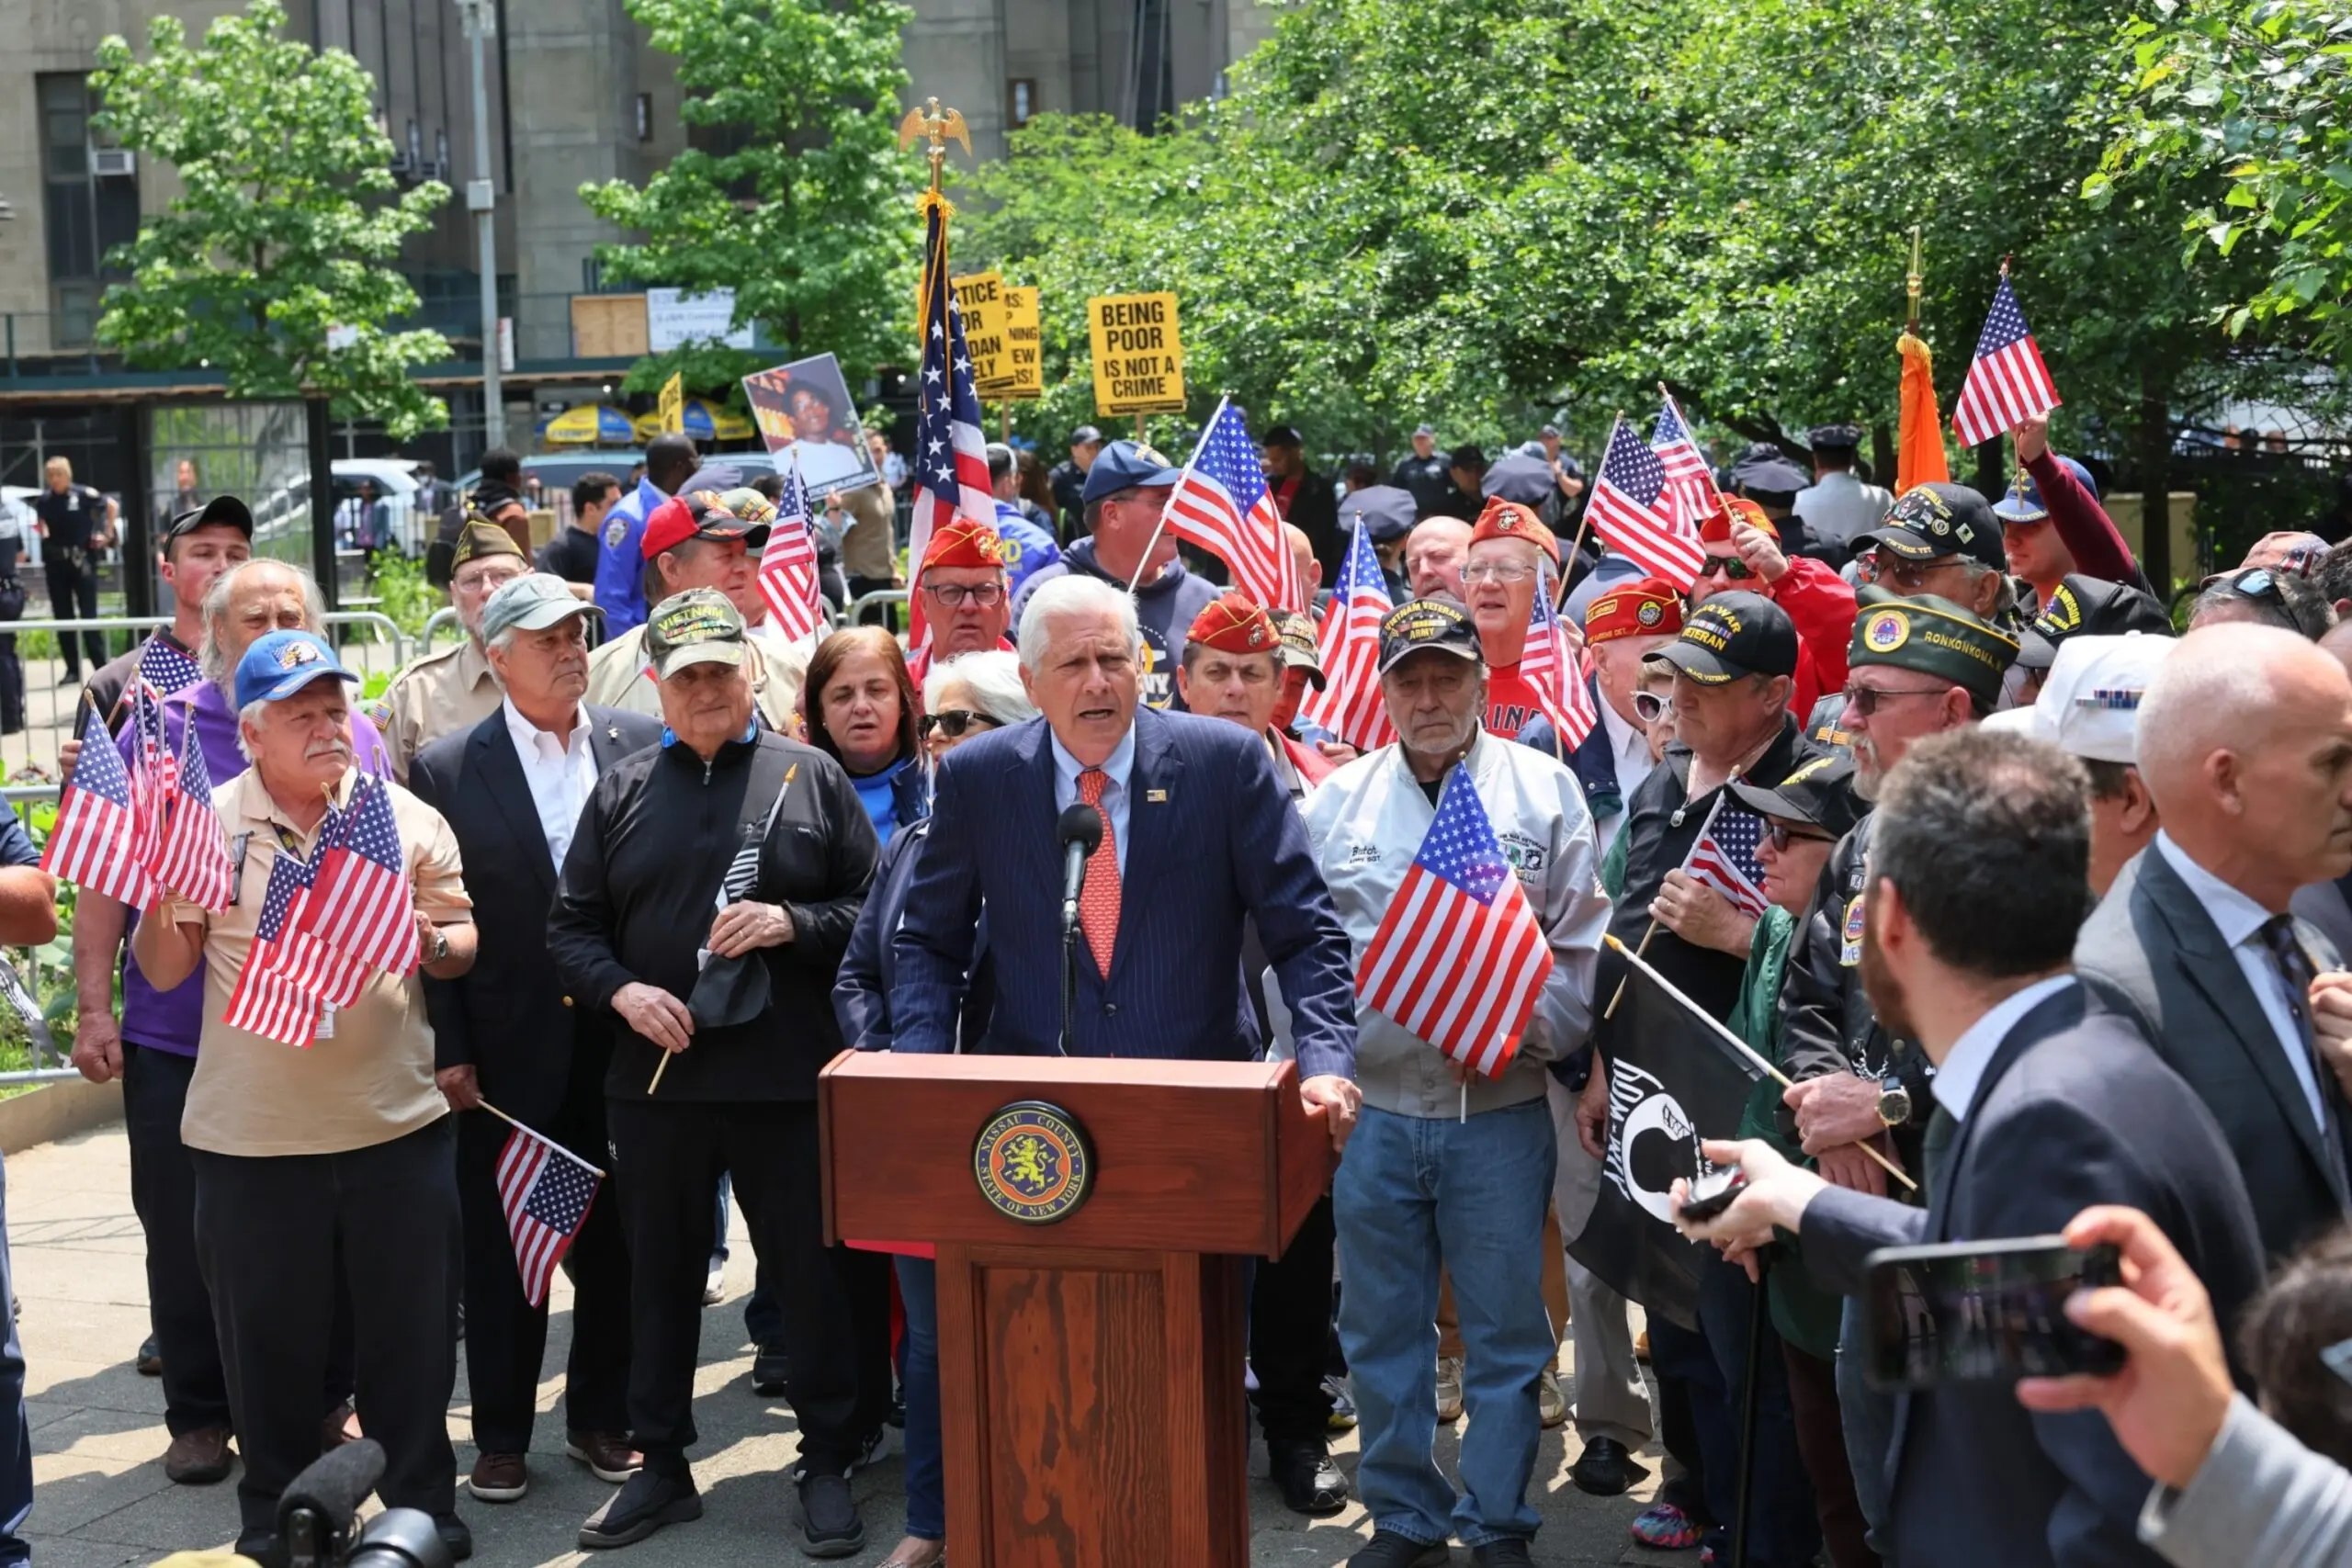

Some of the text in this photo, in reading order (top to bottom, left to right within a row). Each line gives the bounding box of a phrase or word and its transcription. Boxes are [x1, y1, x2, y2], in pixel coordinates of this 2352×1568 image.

[958, 280, 999, 306] TICE
[960, 310, 983, 333] OR
[1102, 300, 1164, 327] BEING
[968, 335, 1001, 357] DAN
[1009, 327, 1037, 341] NING
[1106, 327, 1163, 352] POOR
[1012, 348, 1035, 364] EW
[1103, 355, 1175, 378] IS NOT A
[973, 358, 996, 379] ELY
[1112, 377, 1167, 398] CRIME
[657, 604, 724, 631] VIETNAM
[1384, 601, 1464, 631] VIETNAM VETERAN
[1716, 605, 1742, 633] WAR
[1409, 627, 1434, 640] ARMY
[980, 1114, 1080, 1158] NASSAU COUNTY
[980, 1167, 1081, 1216] STATE OF NEW YORK
